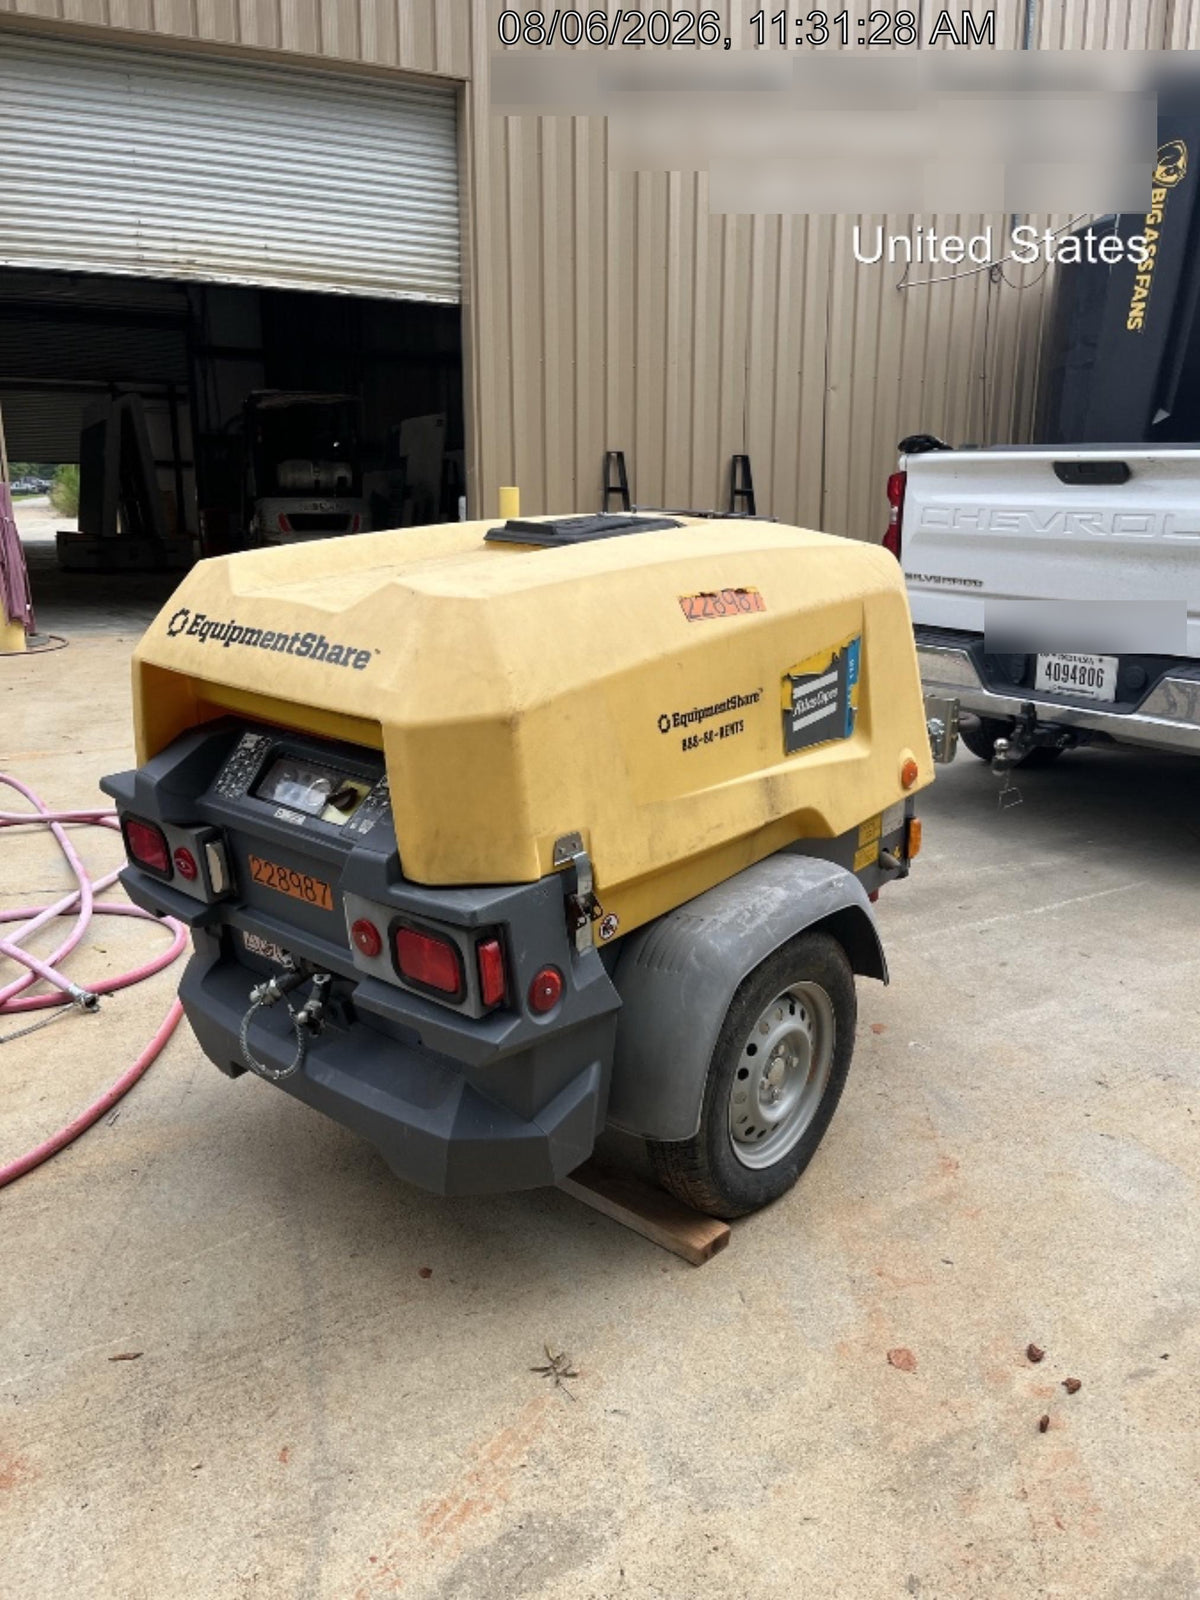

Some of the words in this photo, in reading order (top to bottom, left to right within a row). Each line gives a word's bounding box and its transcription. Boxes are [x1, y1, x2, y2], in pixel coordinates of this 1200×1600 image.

[1146, 188, 1167, 225] BIG
[1126, 274, 1152, 331] FANS
[186, 613, 372, 670] EquipmentShare
[1045, 661, 1105, 689] 4094806
[672, 692, 760, 728] EquipmentShare
[252, 856, 328, 906] 228987
